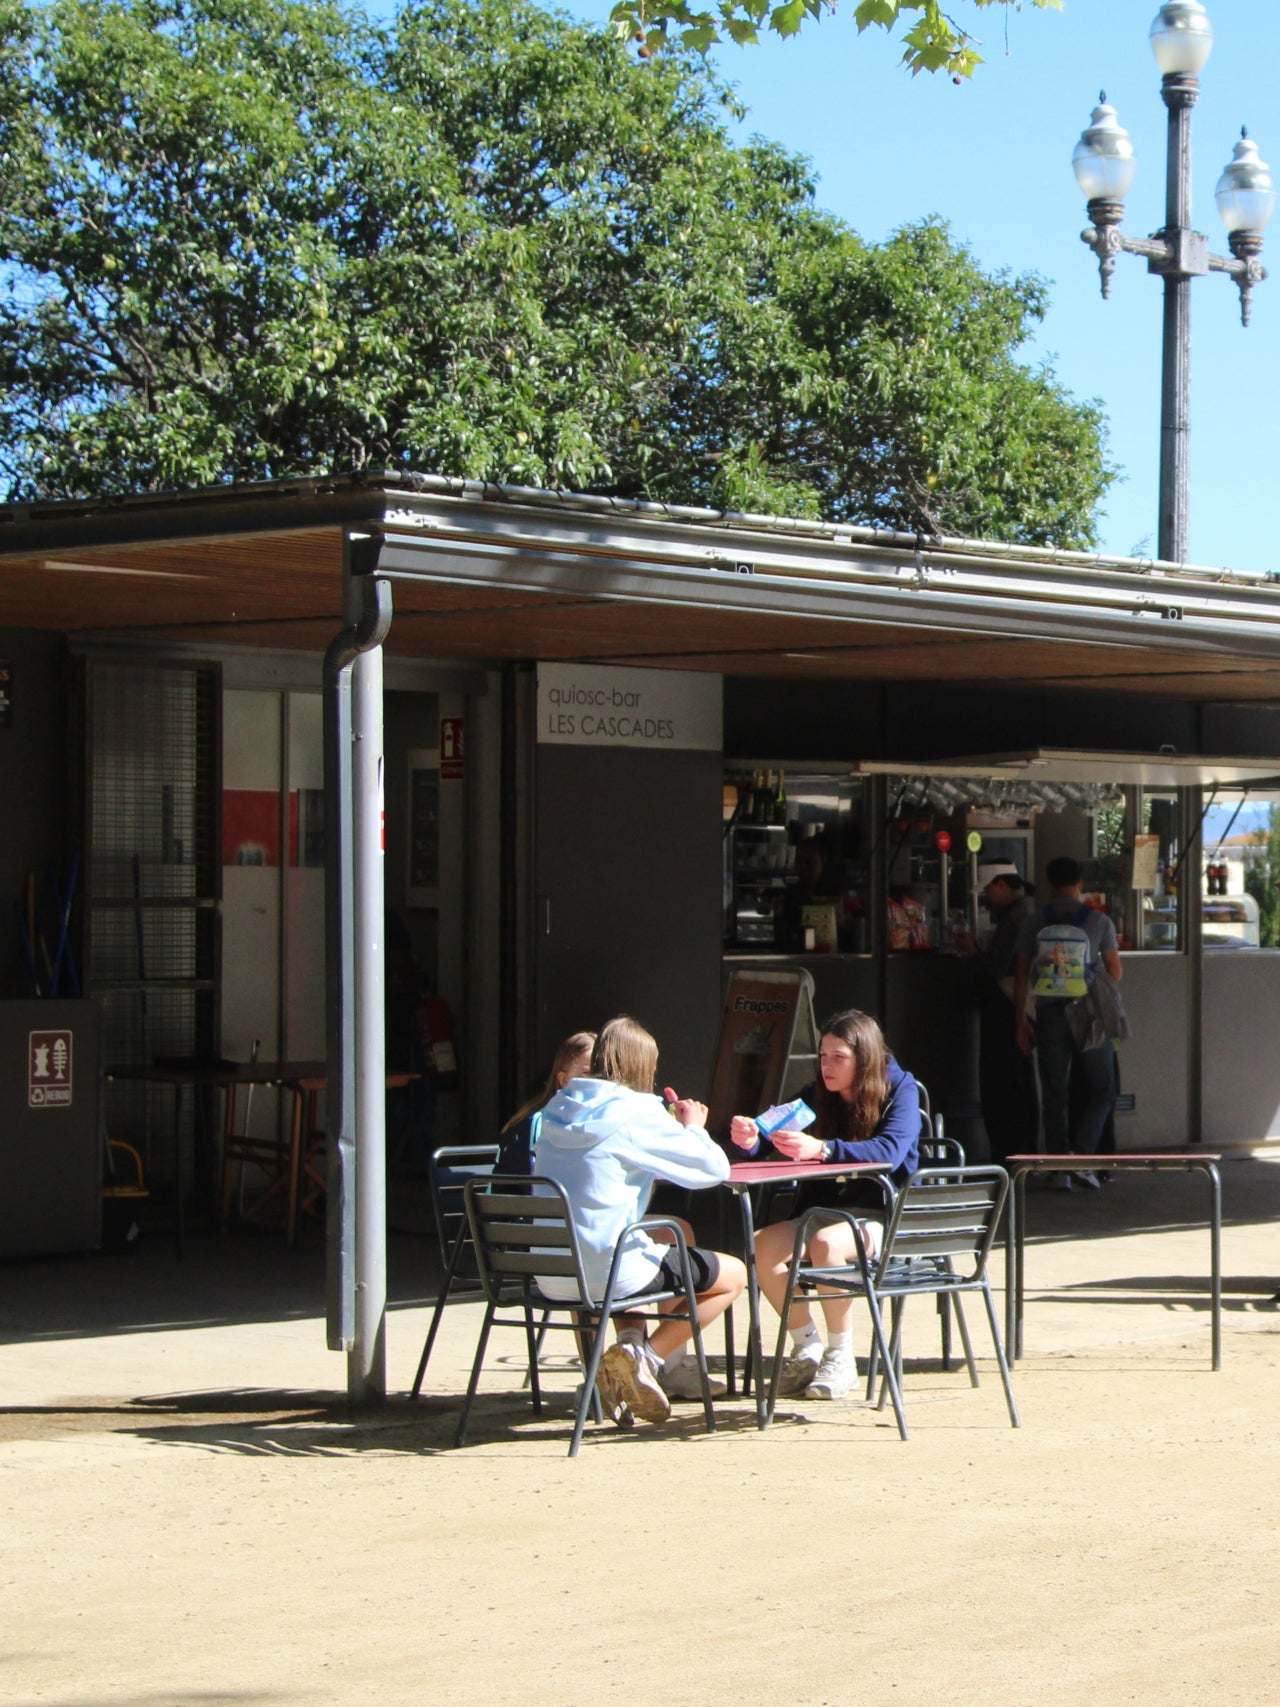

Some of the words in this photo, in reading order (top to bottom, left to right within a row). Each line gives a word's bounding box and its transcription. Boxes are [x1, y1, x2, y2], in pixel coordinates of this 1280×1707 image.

[548, 684, 642, 708] quiosc-bar
[549, 715, 575, 735] LES
[580, 716, 675, 739] CASCADES
